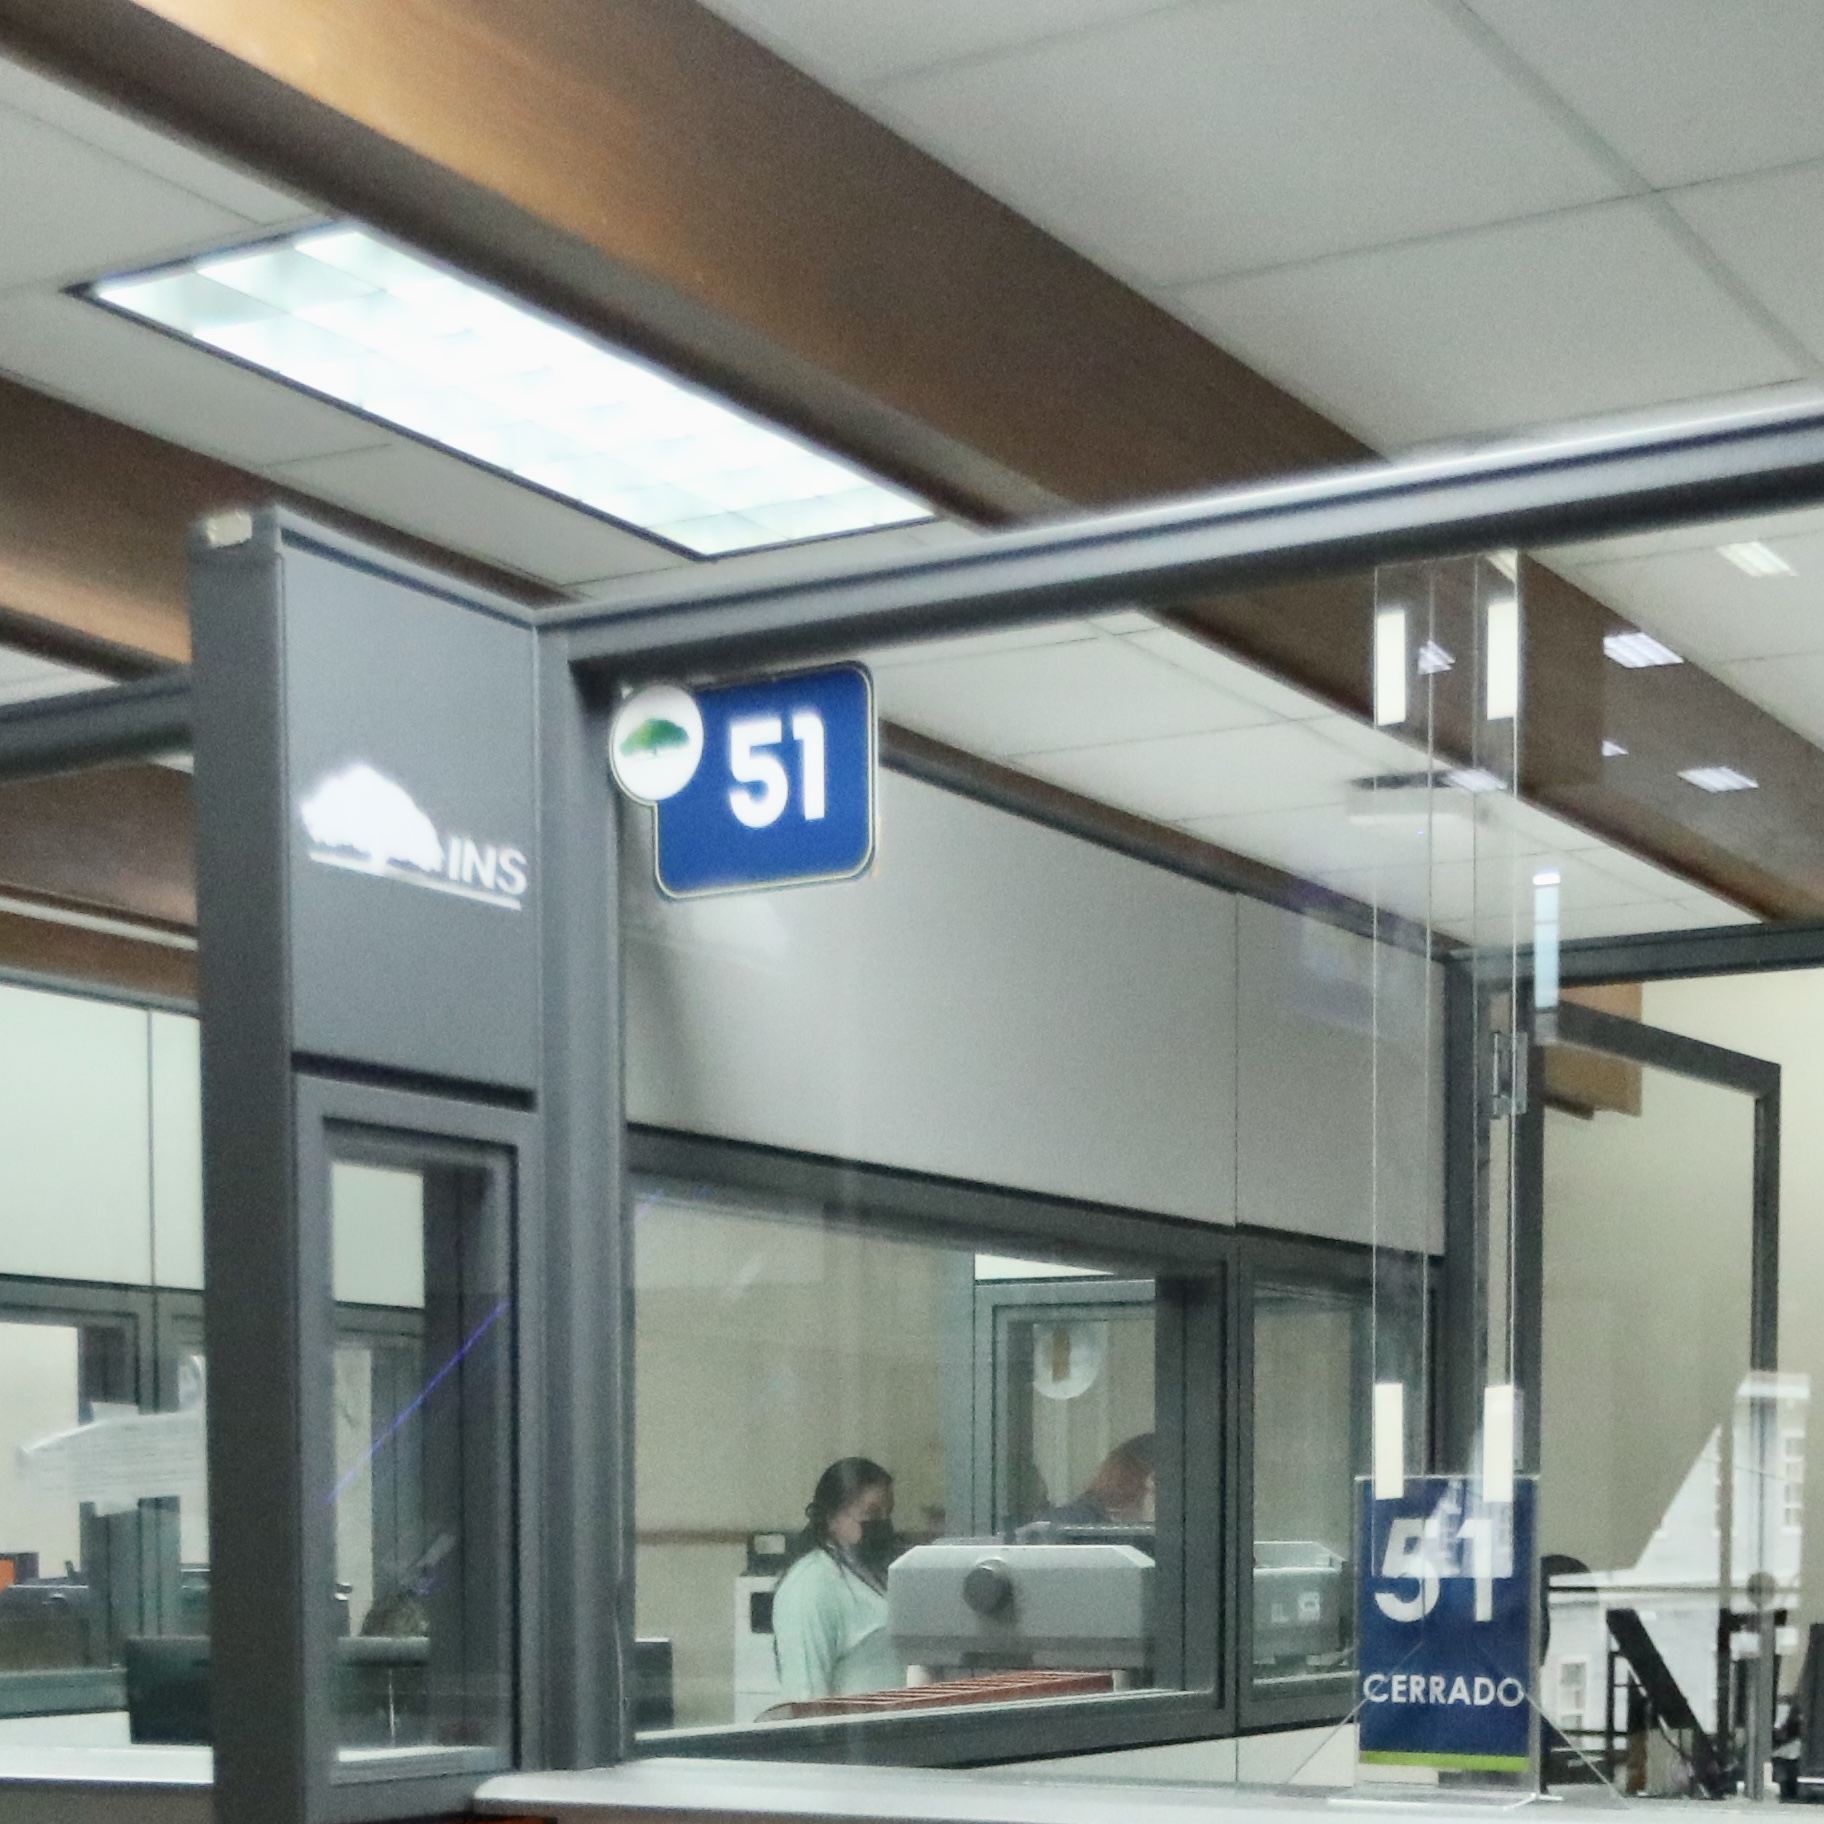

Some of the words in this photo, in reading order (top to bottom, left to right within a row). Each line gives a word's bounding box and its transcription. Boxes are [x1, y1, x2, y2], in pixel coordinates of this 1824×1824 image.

[727, 706, 826, 829] 51
[448, 835, 529, 896] INS
[1374, 1517, 1494, 1623] 51
[1362, 1672, 1526, 1708] CERRADO
